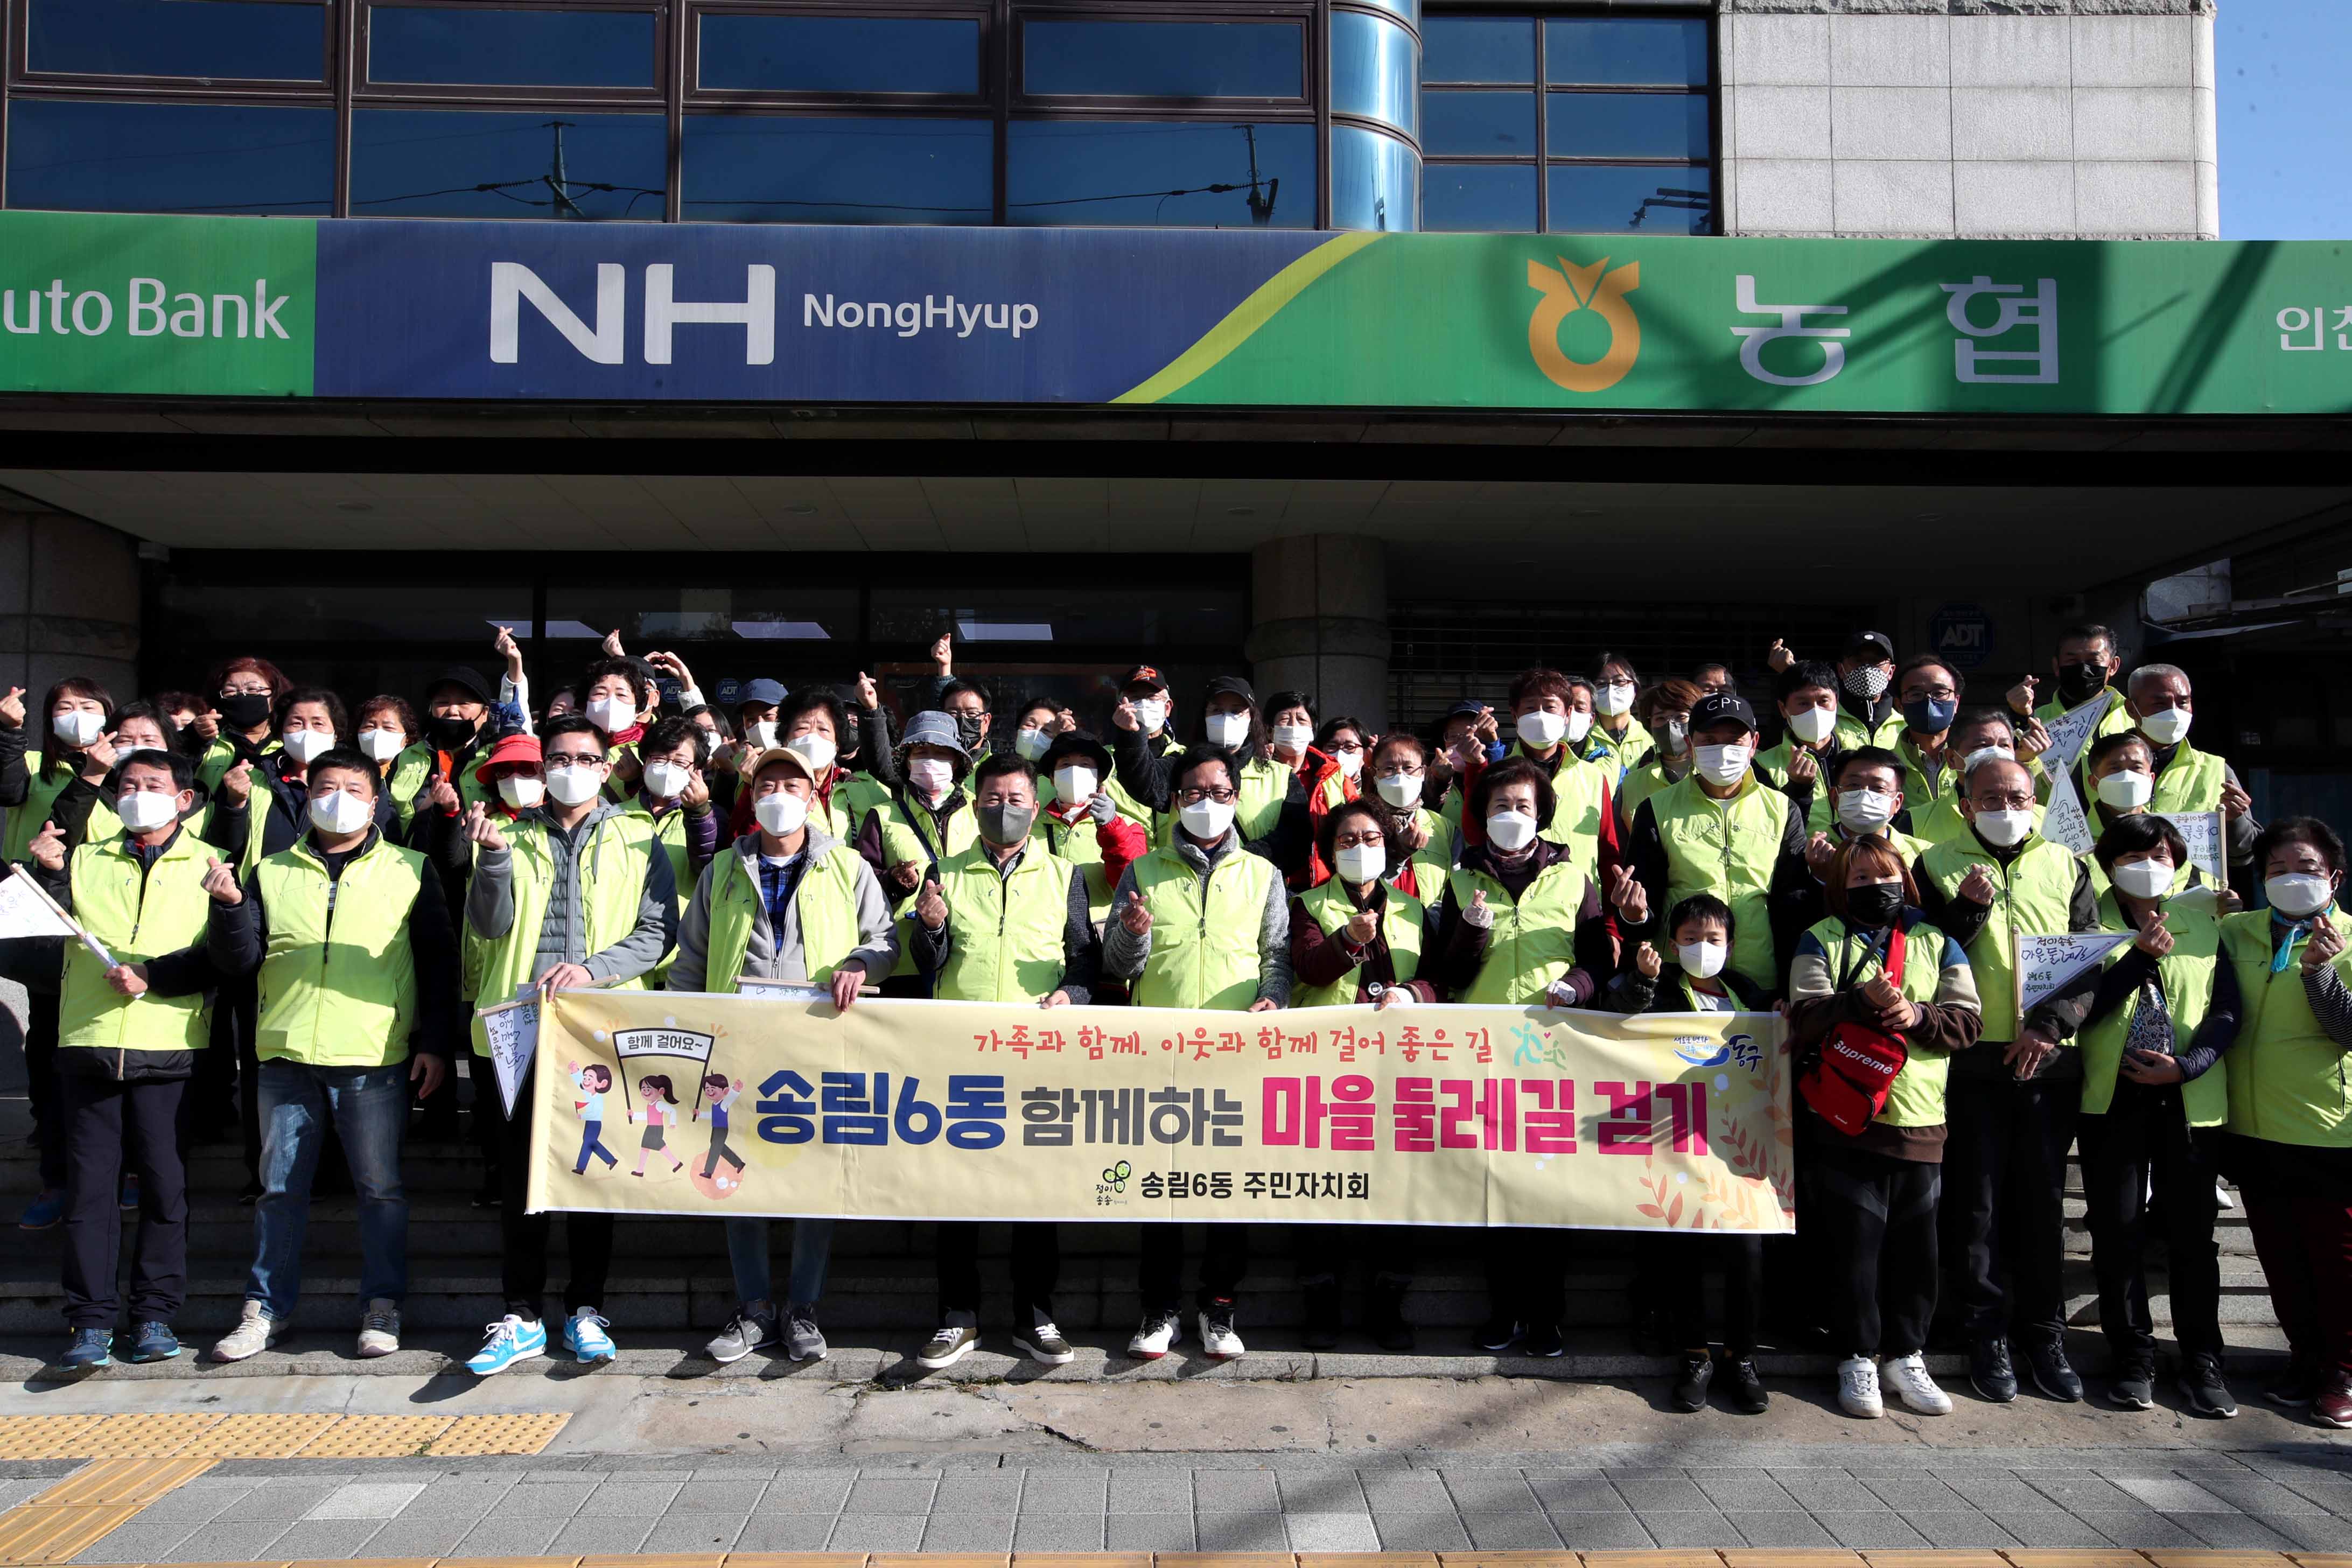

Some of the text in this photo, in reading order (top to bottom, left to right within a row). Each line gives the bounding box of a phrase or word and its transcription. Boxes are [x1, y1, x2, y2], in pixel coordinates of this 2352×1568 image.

[129, 277, 290, 340] Bank
[490, 262, 1039, 365] NH NongHyup
[1730, 274, 2059, 387] 농협
[1940, 624, 1985, 647] ADT
[720, 686, 737, 695] ADT
[1706, 697, 1741, 711] CPT
[2037, 935, 2076, 947] 정이송송
[2021, 947, 2047, 963] 마을
[627, 1035, 652, 1049] 함께
[974, 1024, 1493, 1064] 가족과 함께. 이웃과 함께 걸어 좋은 길
[1728, 1034, 1763, 1073] 동구
[1833, 1040, 1894, 1075] Supreme
[756, 1069, 1709, 1156] 송림6동 함께하는 마을 둘레길 걷기
[1096, 1184, 1113, 1194] 정이
[1140, 1171, 1370, 1200] 송림6동 주민자치회
[1096, 1195, 1113, 1206] 송송
